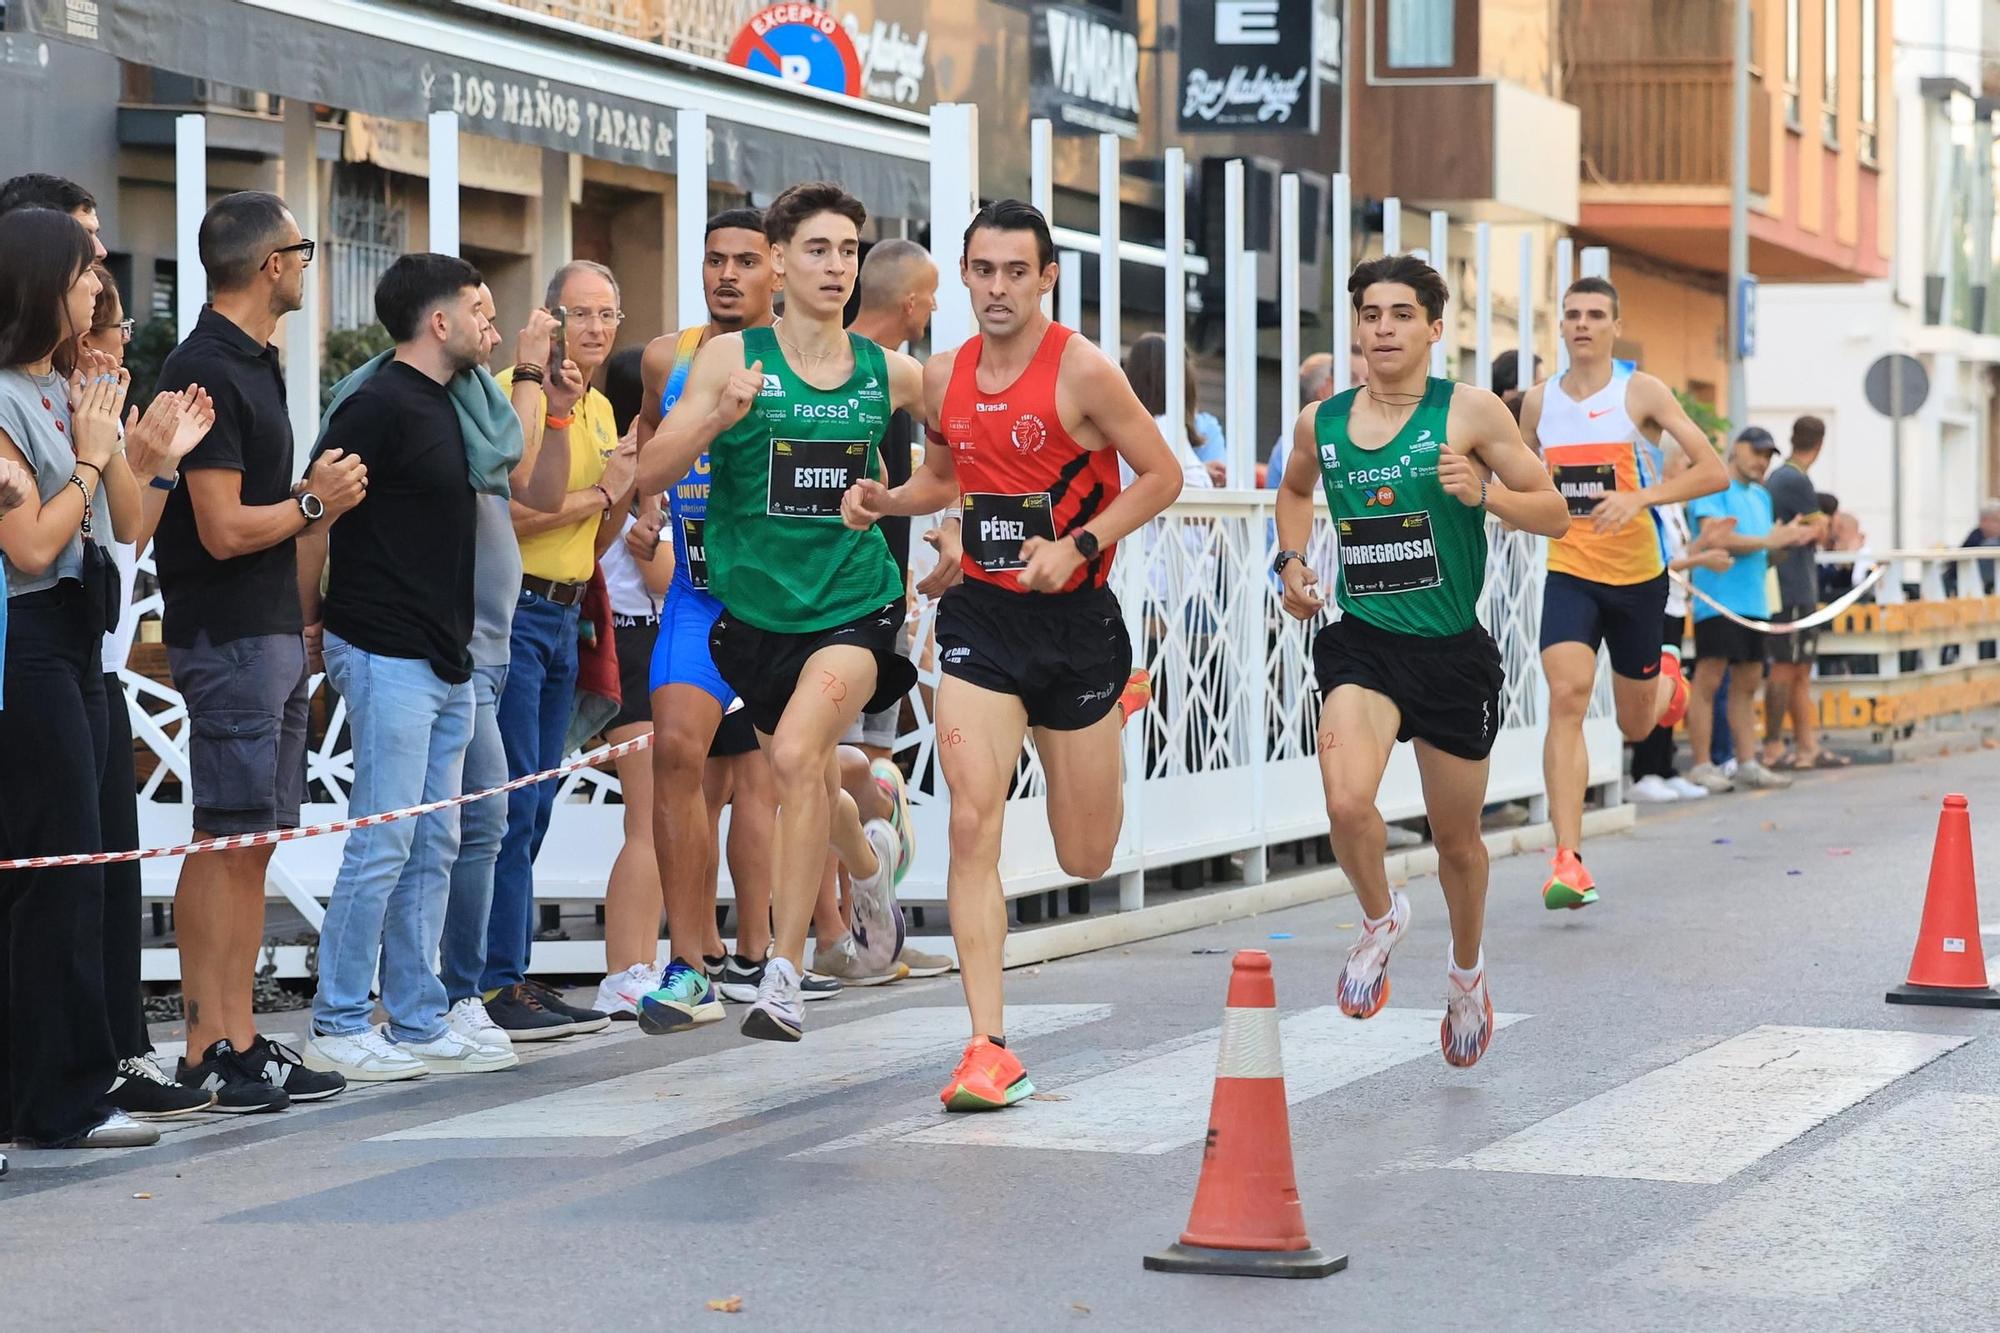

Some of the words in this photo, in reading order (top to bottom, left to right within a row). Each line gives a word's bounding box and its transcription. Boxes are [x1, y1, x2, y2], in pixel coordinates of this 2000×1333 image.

[751, 5, 837, 37] EXCEPTO
[781, 55, 811, 83] P
[1046, 8, 1141, 114] VAMBAR
[452, 72, 497, 120] LOS
[502, 79, 581, 138] MAÑOS
[586, 101, 652, 153] TAPAS
[654, 121, 674, 157] &
[793, 404, 849, 419] Facsa
[794, 467, 848, 488] ESTEVE
[1347, 465, 1402, 485] Facsa
[1379, 491, 1394, 501] Fer
[980, 515, 1026, 541] PÉREZ
[1341, 538, 1434, 565] TORREGROSSA
[821, 670, 848, 714] 72
